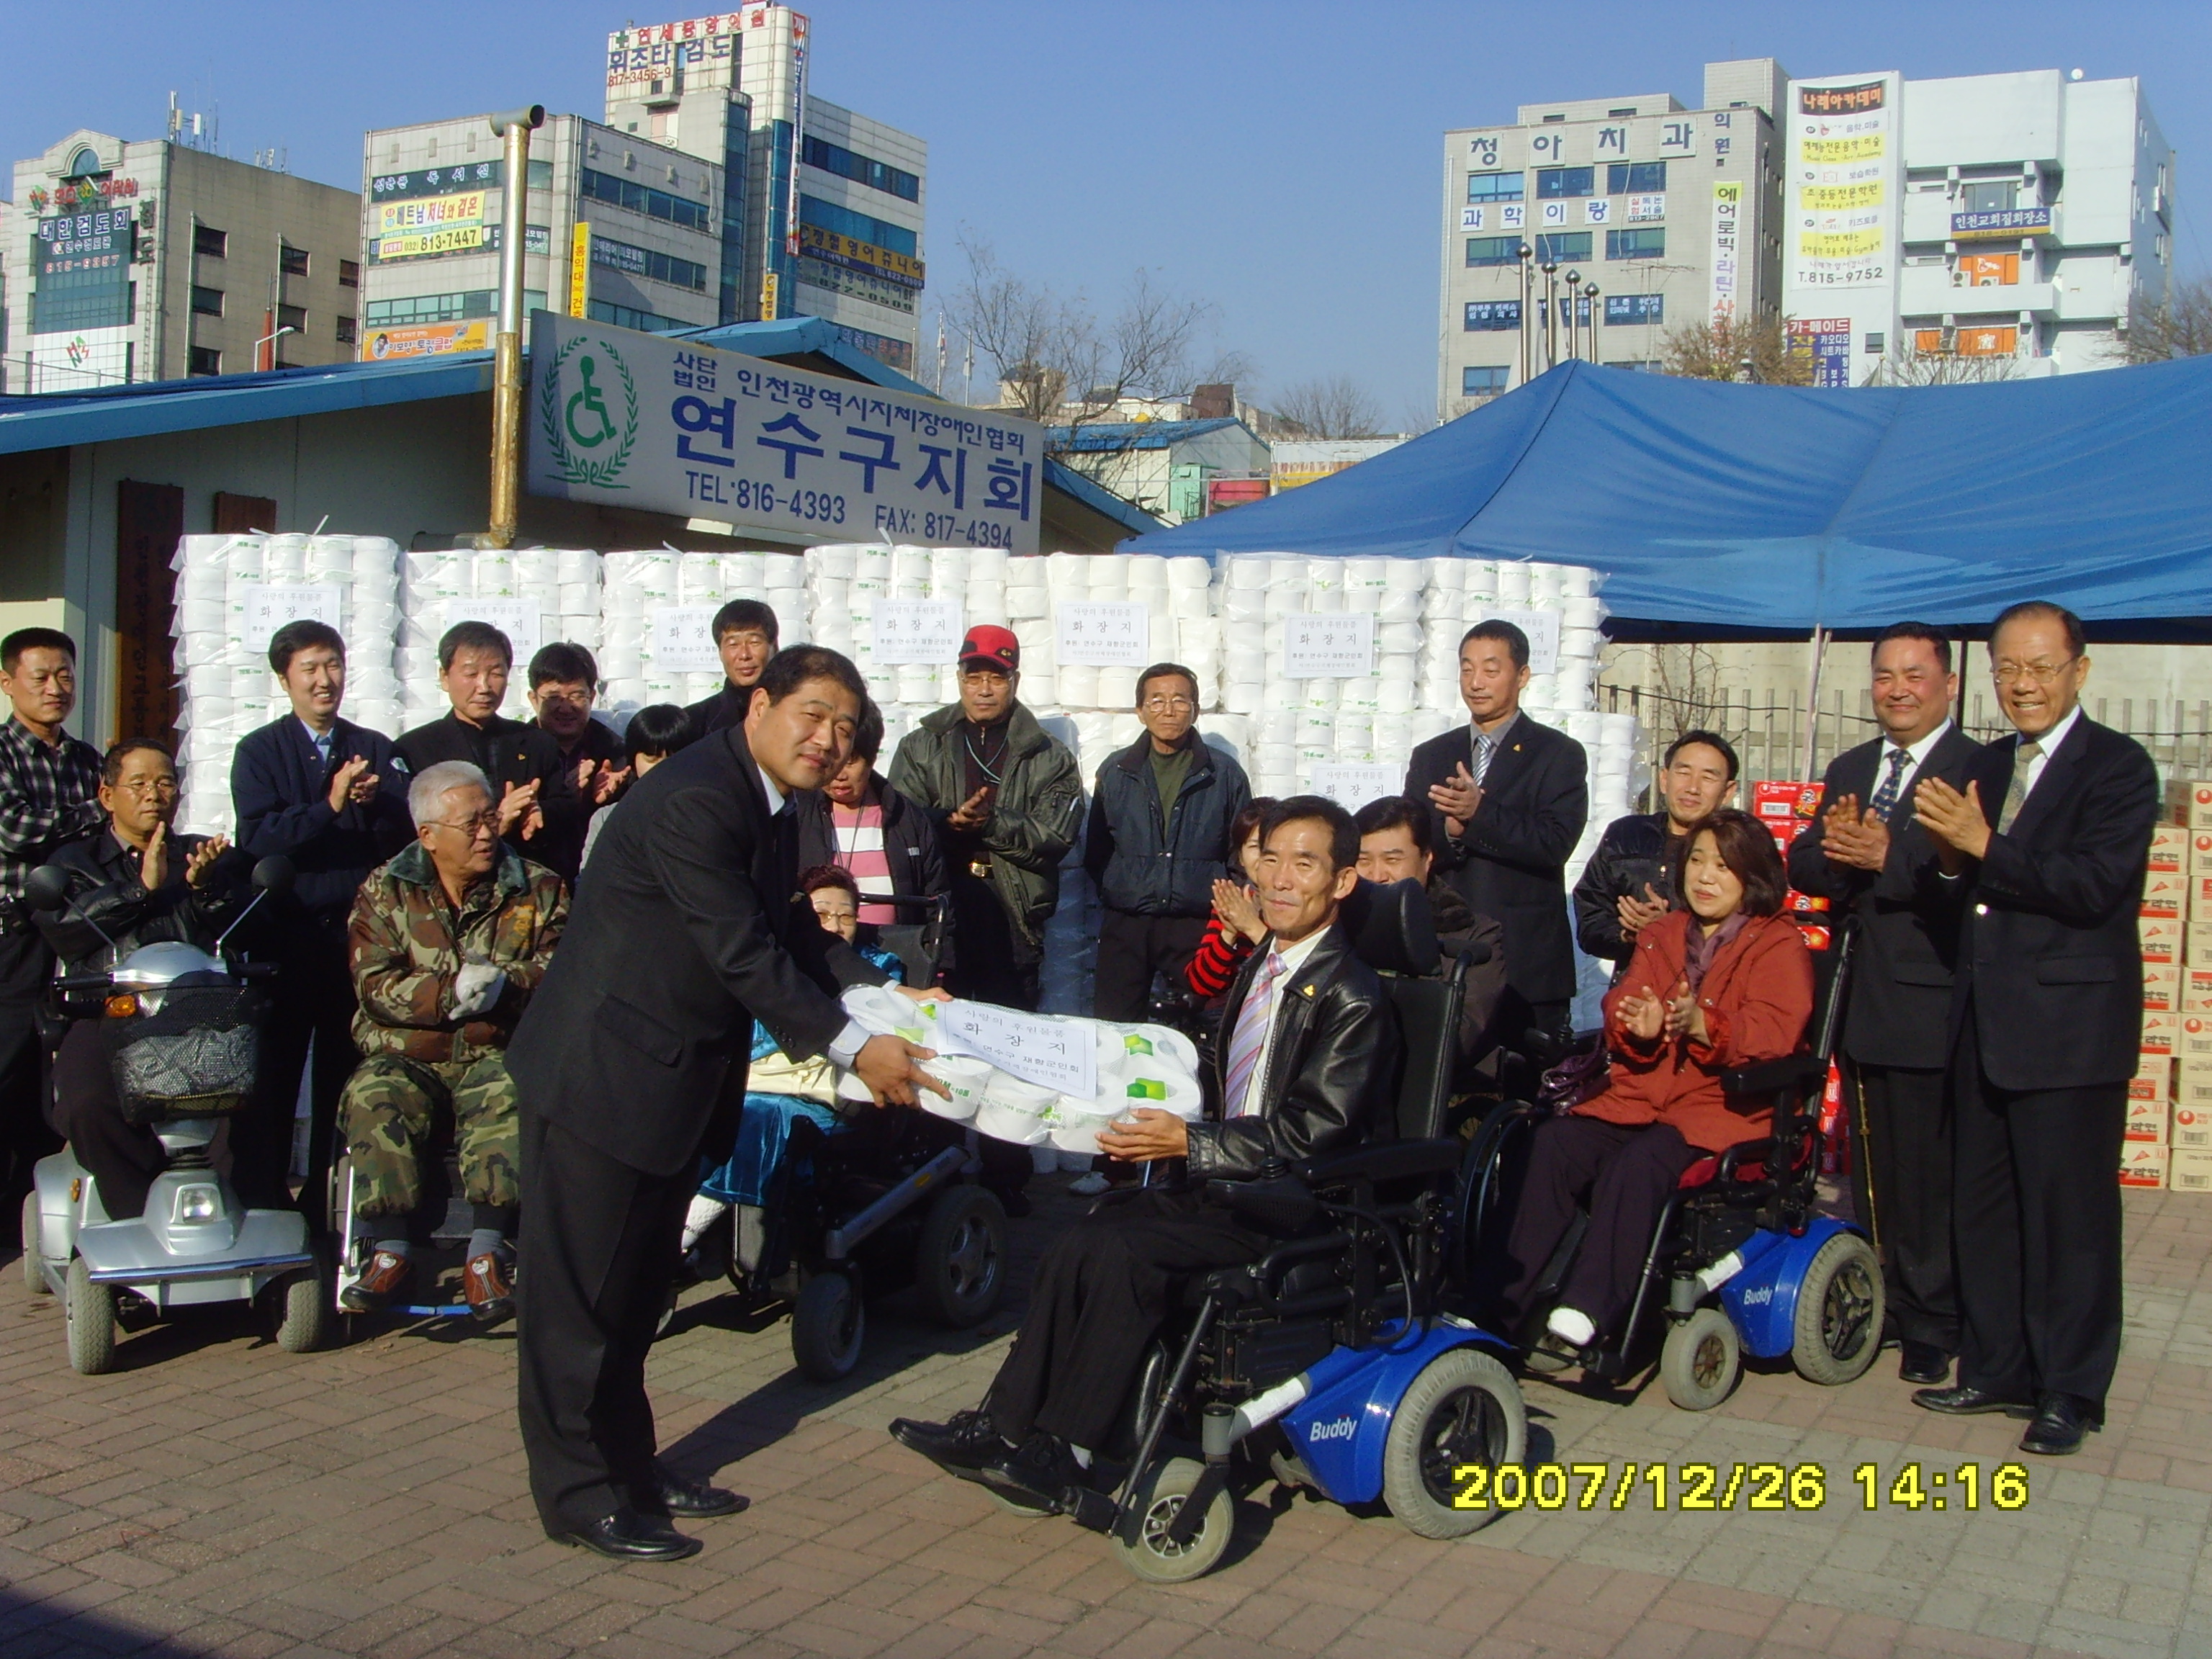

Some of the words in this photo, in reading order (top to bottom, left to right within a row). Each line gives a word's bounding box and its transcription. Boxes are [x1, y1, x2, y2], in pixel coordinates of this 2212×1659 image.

[637, 9, 765, 45] 연세중앙의원
[685, 35, 731, 63] 검도
[608, 67, 671, 87] 817-3456-9
[1470, 121, 1694, 167] 청아치과
[40, 209, 129, 241] 대한검도회
[1462, 202, 1610, 228] 과학이랑
[1955, 212, 2047, 229] 인천교회집회장소
[1820, 333, 1849, 345] 카오디오
[673, 351, 718, 375] 사단
[673, 369, 716, 393] 법인
[737, 368, 1025, 456] 인천광역시지체장애인협회
[670, 395, 1033, 522] 연수구지회
[924, 512, 1013, 550] 817-4394
[669, 626, 706, 639] 화장
[2143, 942, 2172, 953] 라면
[964, 1008, 1003, 1027] 사랑의
[2143, 1035, 2172, 1046] 라면
[2128, 1122, 2158, 1133] 라면
[2129, 1166, 2161, 1178] 라면
[1743, 1286, 1773, 1305] Buddy
[1310, 1416, 1358, 1442] Buddy
